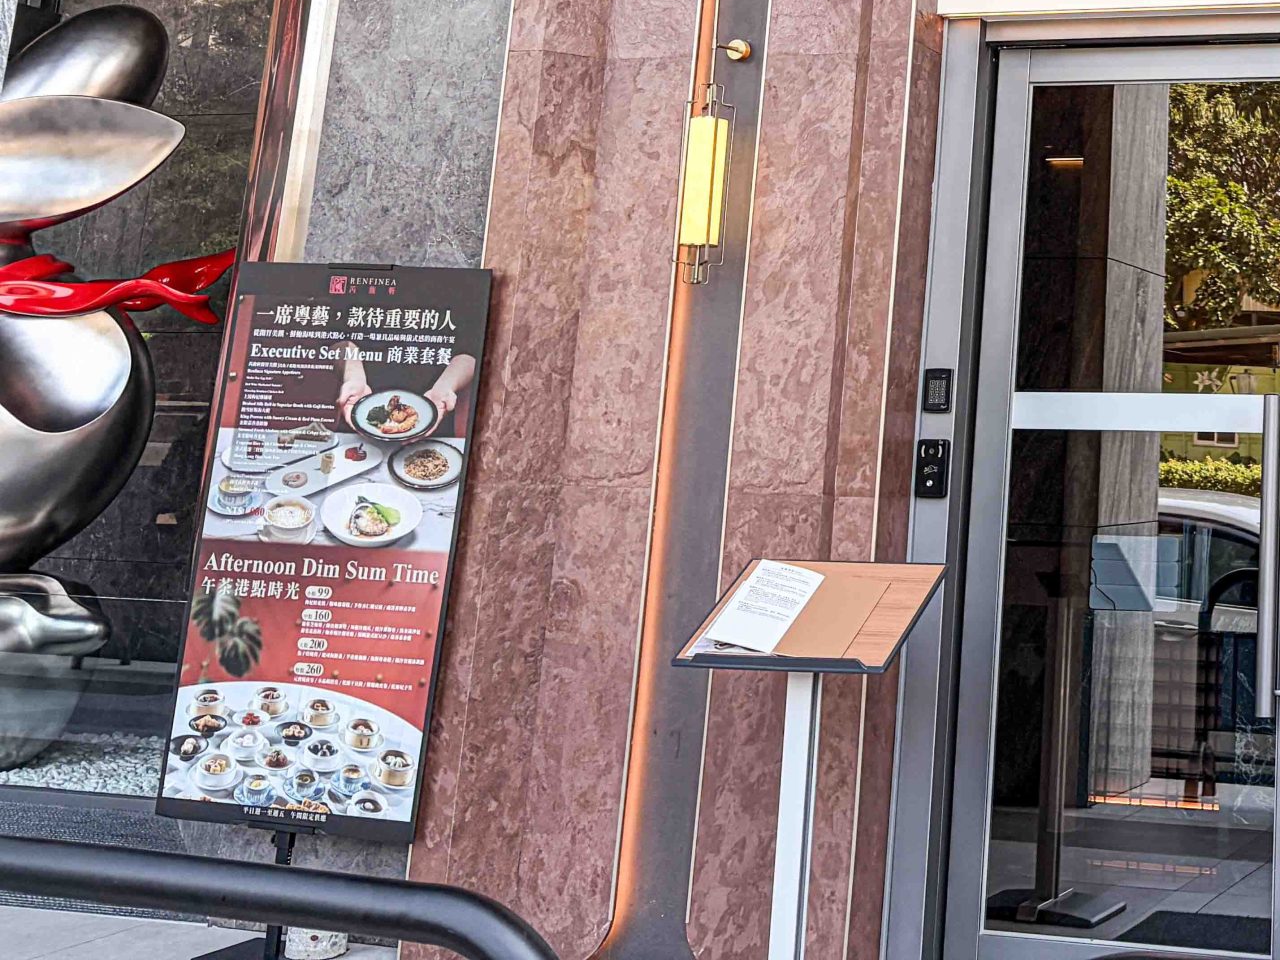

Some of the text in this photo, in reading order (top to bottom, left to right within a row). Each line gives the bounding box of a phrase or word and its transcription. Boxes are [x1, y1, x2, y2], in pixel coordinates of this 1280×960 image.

[350, 277, 397, 286] RENFINEA
[250, 343, 384, 362] Executive Set Menu
[387, 345, 452, 366] 商業套餐
[203, 552, 440, 584] Afternoon Dim Sum Time
[201, 576, 300, 600] 午茶港點時光
[318, 587, 330, 597] 99
[314, 610, 330, 620] 160
[309, 639, 325, 649] 200
[305, 664, 322, 675] 260
